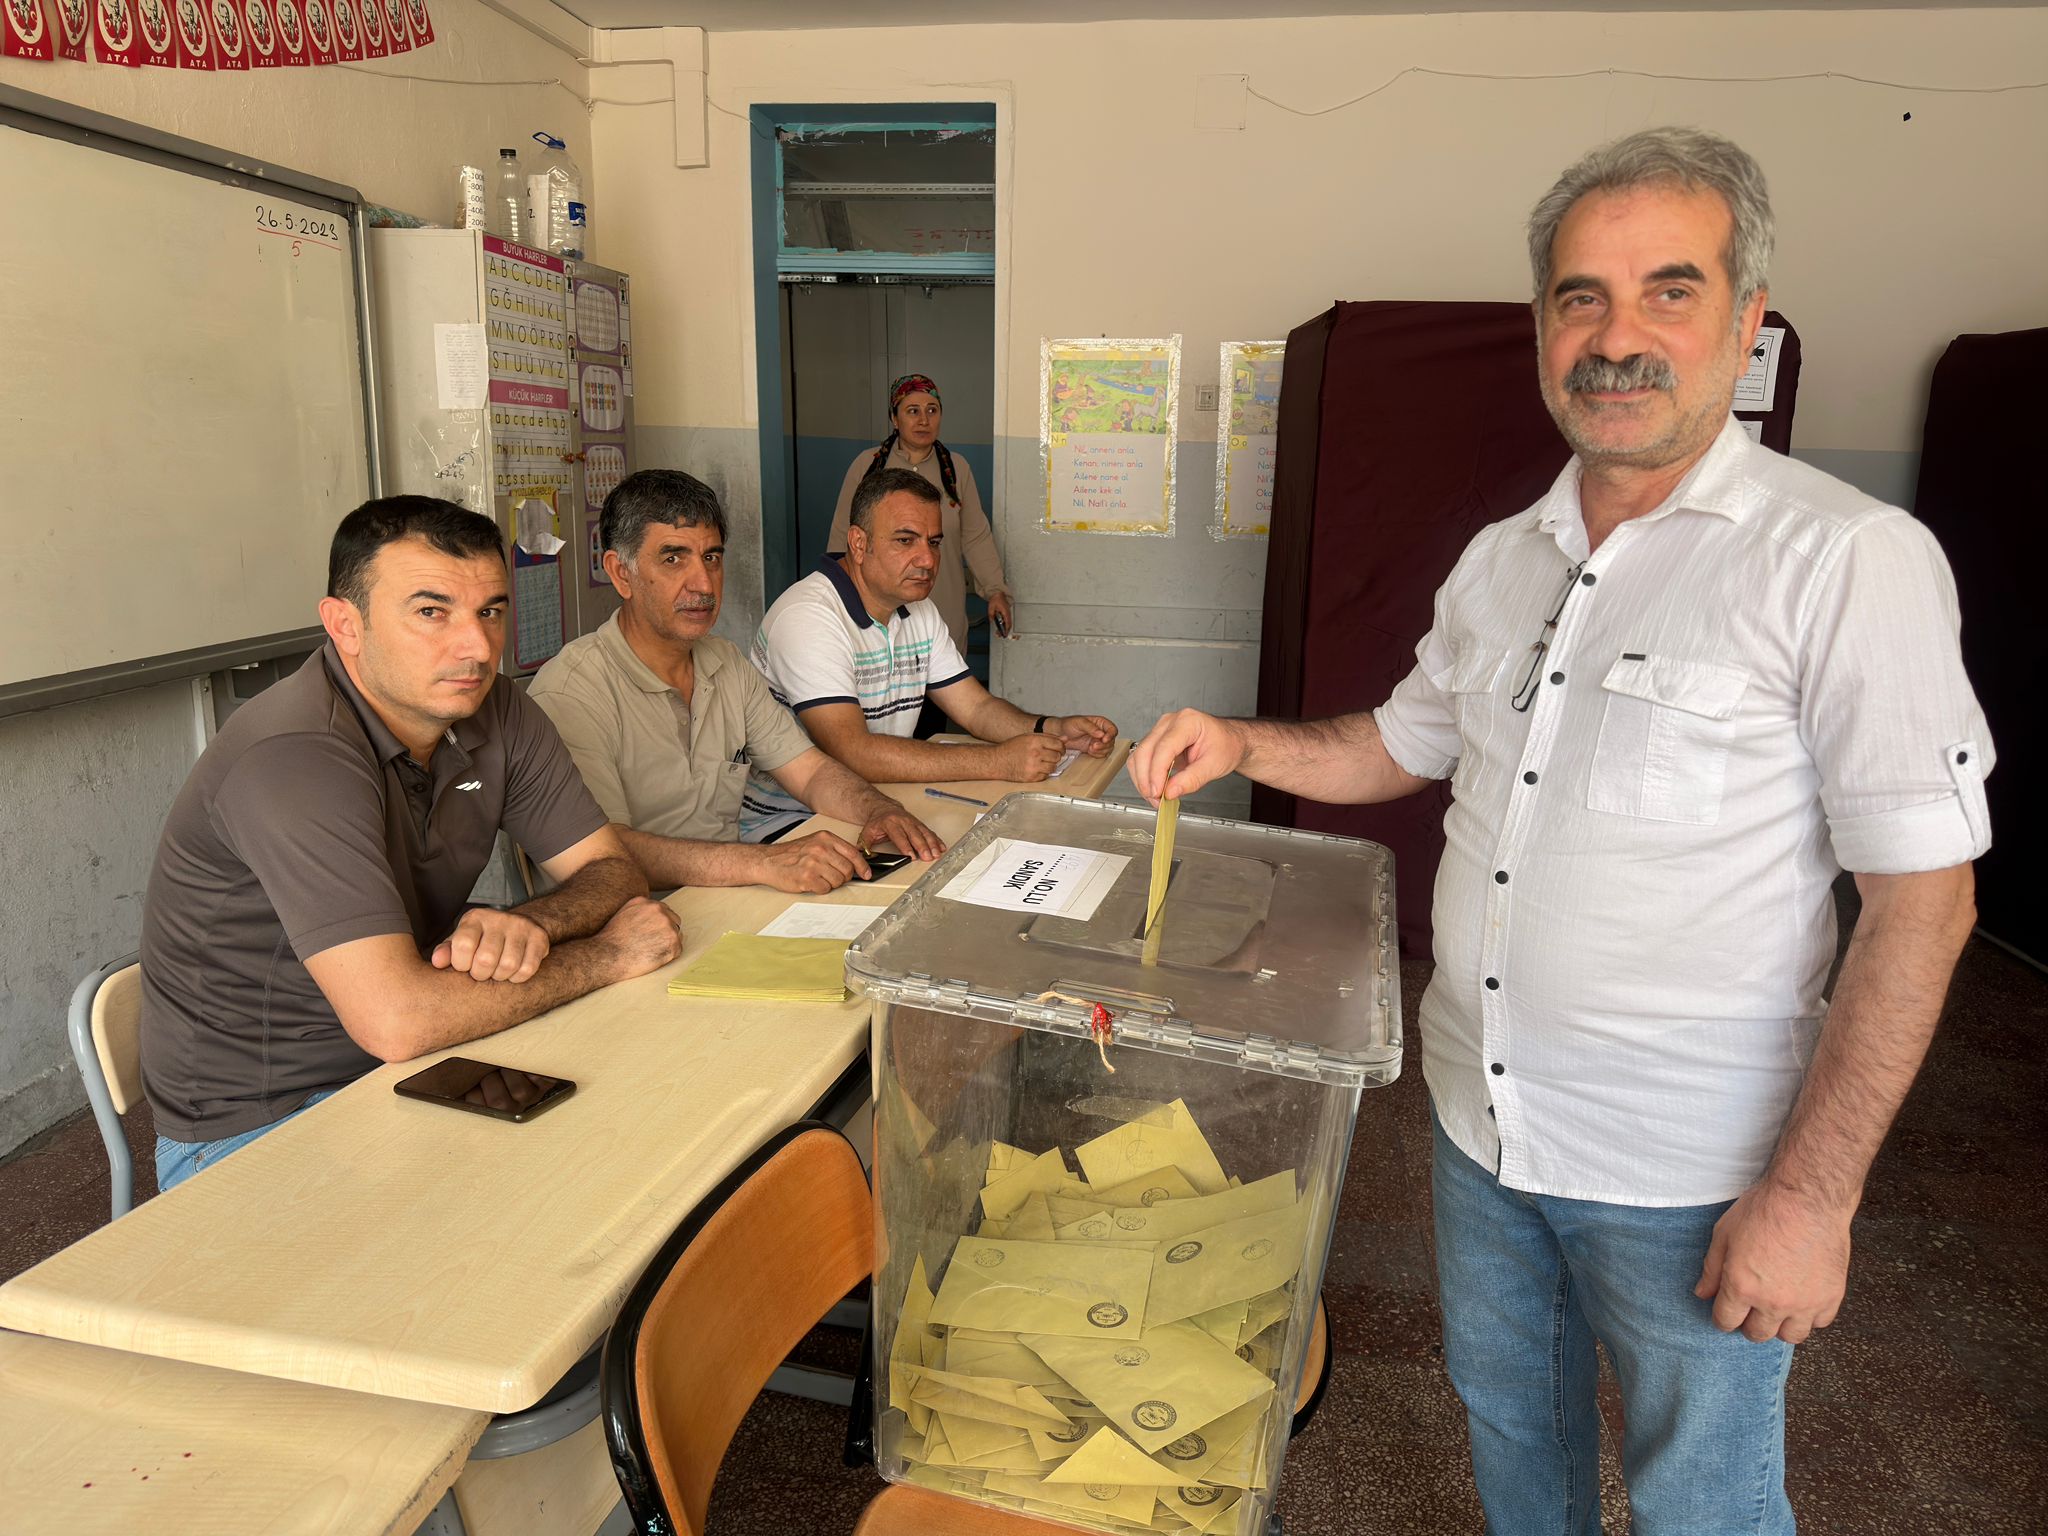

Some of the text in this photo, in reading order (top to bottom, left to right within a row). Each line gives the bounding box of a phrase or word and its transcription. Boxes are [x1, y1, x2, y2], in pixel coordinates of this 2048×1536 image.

[420, 36, 430, 45] ATA
[18, 46, 42, 57] ATA
[65, 47, 78, 58] ATA
[396, 44, 407, 52] ATA
[106, 53, 129, 64] ATA
[149, 56, 168, 65] ATA
[290, 56, 304, 64] ATA
[321, 55, 333, 63] ATA
[345, 52, 358, 60] ATA
[190, 59, 207, 68] ATA
[226, 60, 242, 68] ATA
[260, 58, 274, 66] ATA
[256, 205, 338, 241] 26.5.2023
[292, 241, 302, 257] 5
[1003, 859, 1044, 890] SANDIK
